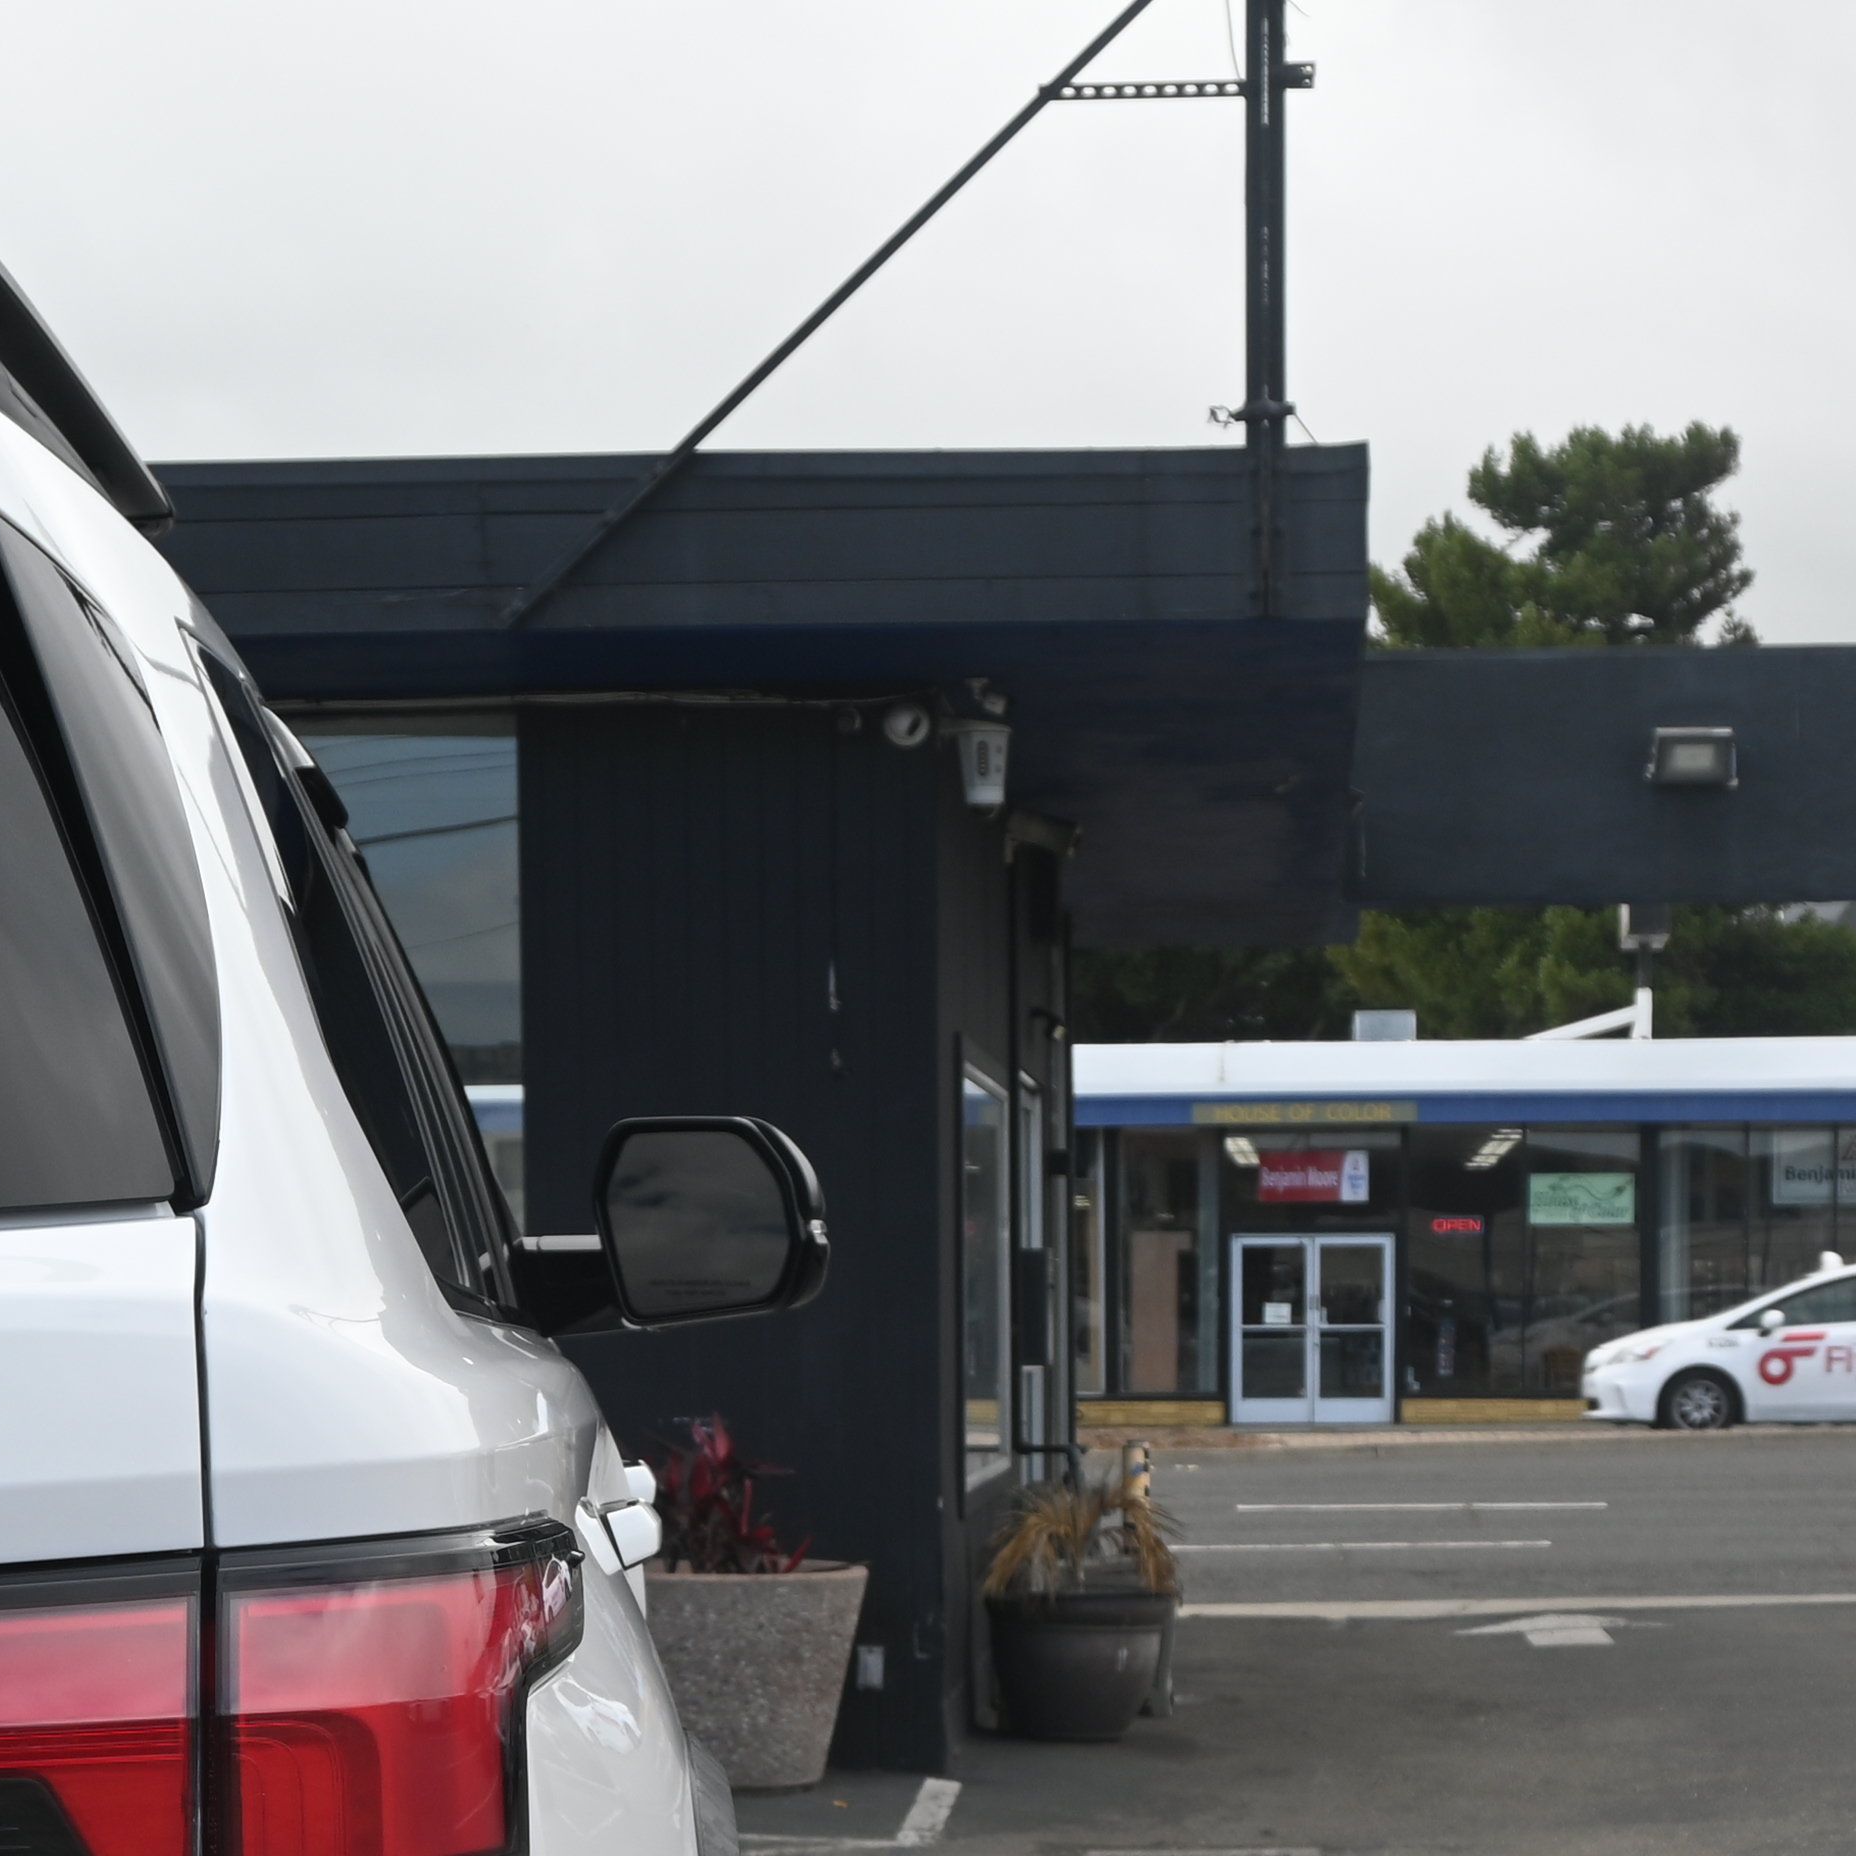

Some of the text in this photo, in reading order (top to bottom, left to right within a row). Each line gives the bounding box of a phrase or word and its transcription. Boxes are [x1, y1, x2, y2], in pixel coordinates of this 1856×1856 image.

[1215, 1103, 1392, 1121] HOUSE OF COLOR
[1262, 1167, 1306, 1191] Benjamin
[1308, 1166, 1338, 1187] Moore
[1431, 1217, 1483, 1233] OPEN
